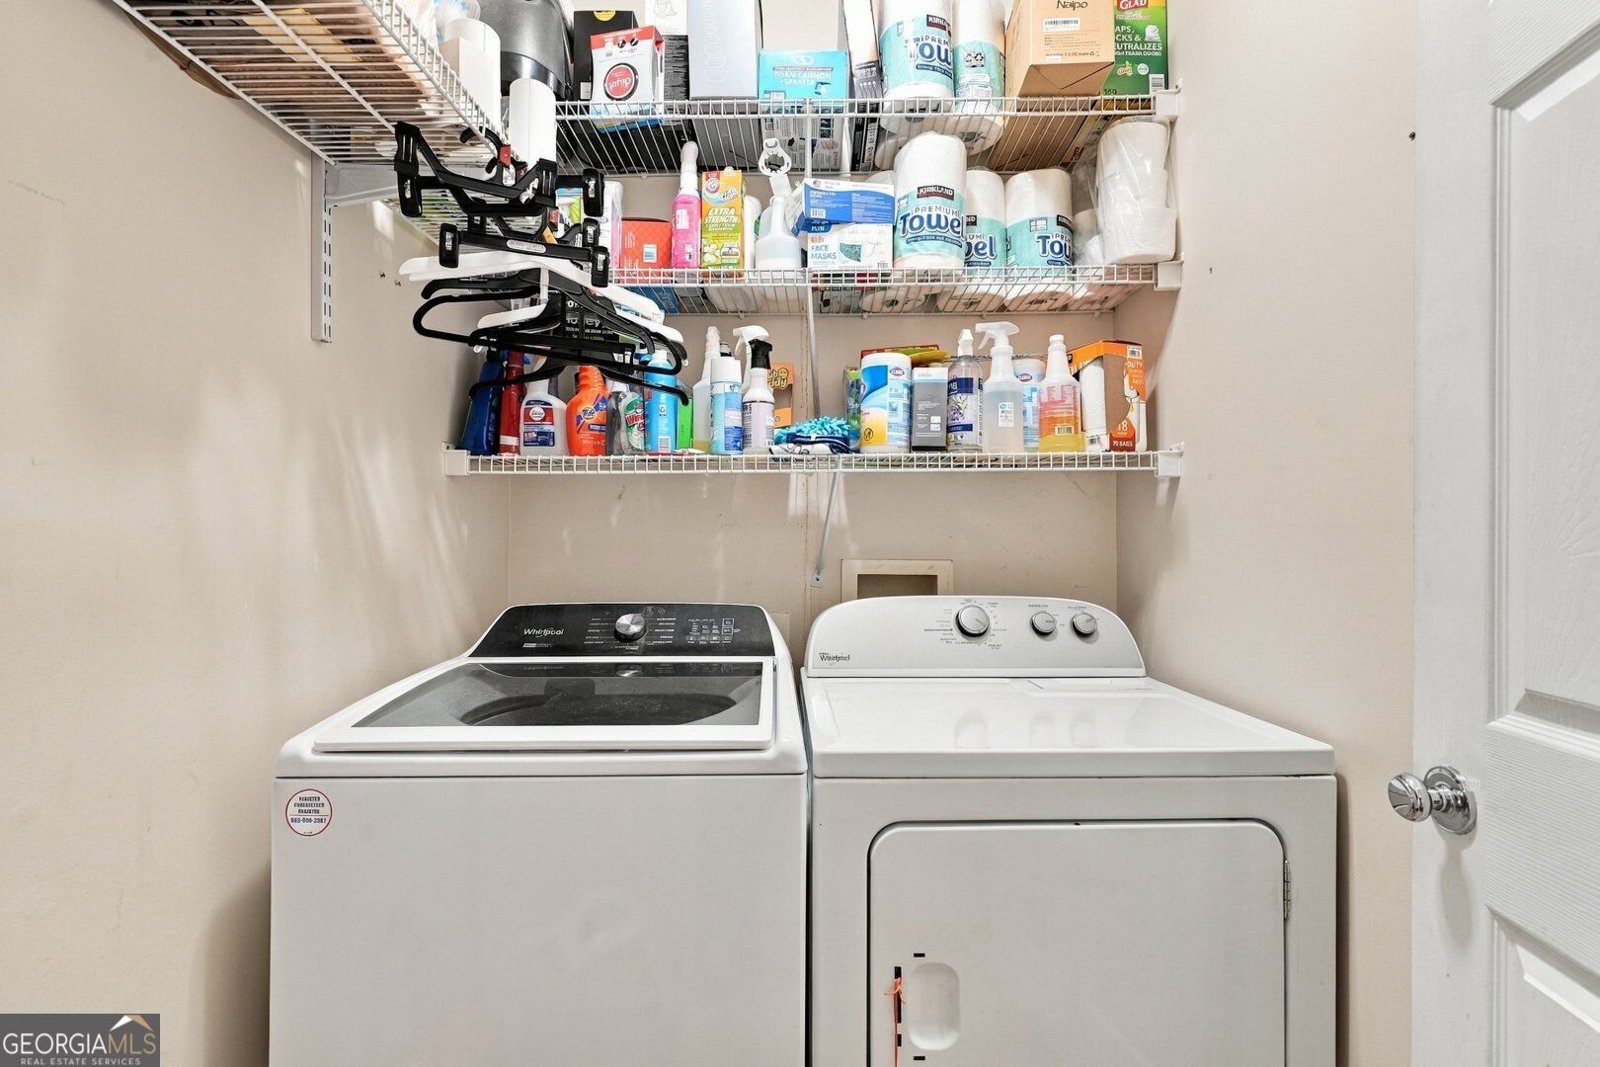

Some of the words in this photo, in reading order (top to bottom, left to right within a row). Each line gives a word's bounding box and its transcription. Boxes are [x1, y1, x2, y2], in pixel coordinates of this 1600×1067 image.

[1056, 0, 1088, 10] Naipo
[1119, 0, 1147, 10] GLAD
[1134, 34, 1142, 42] &
[1115, 42, 1163, 50] UTRALIZES
[919, 186, 953, 196] KIRKLAND
[708, 208, 736, 216] EXTRA
[914, 205, 958, 216] PREMIUM
[704, 215, 740, 224] STRENGTH
[900, 213, 964, 238] Towel
